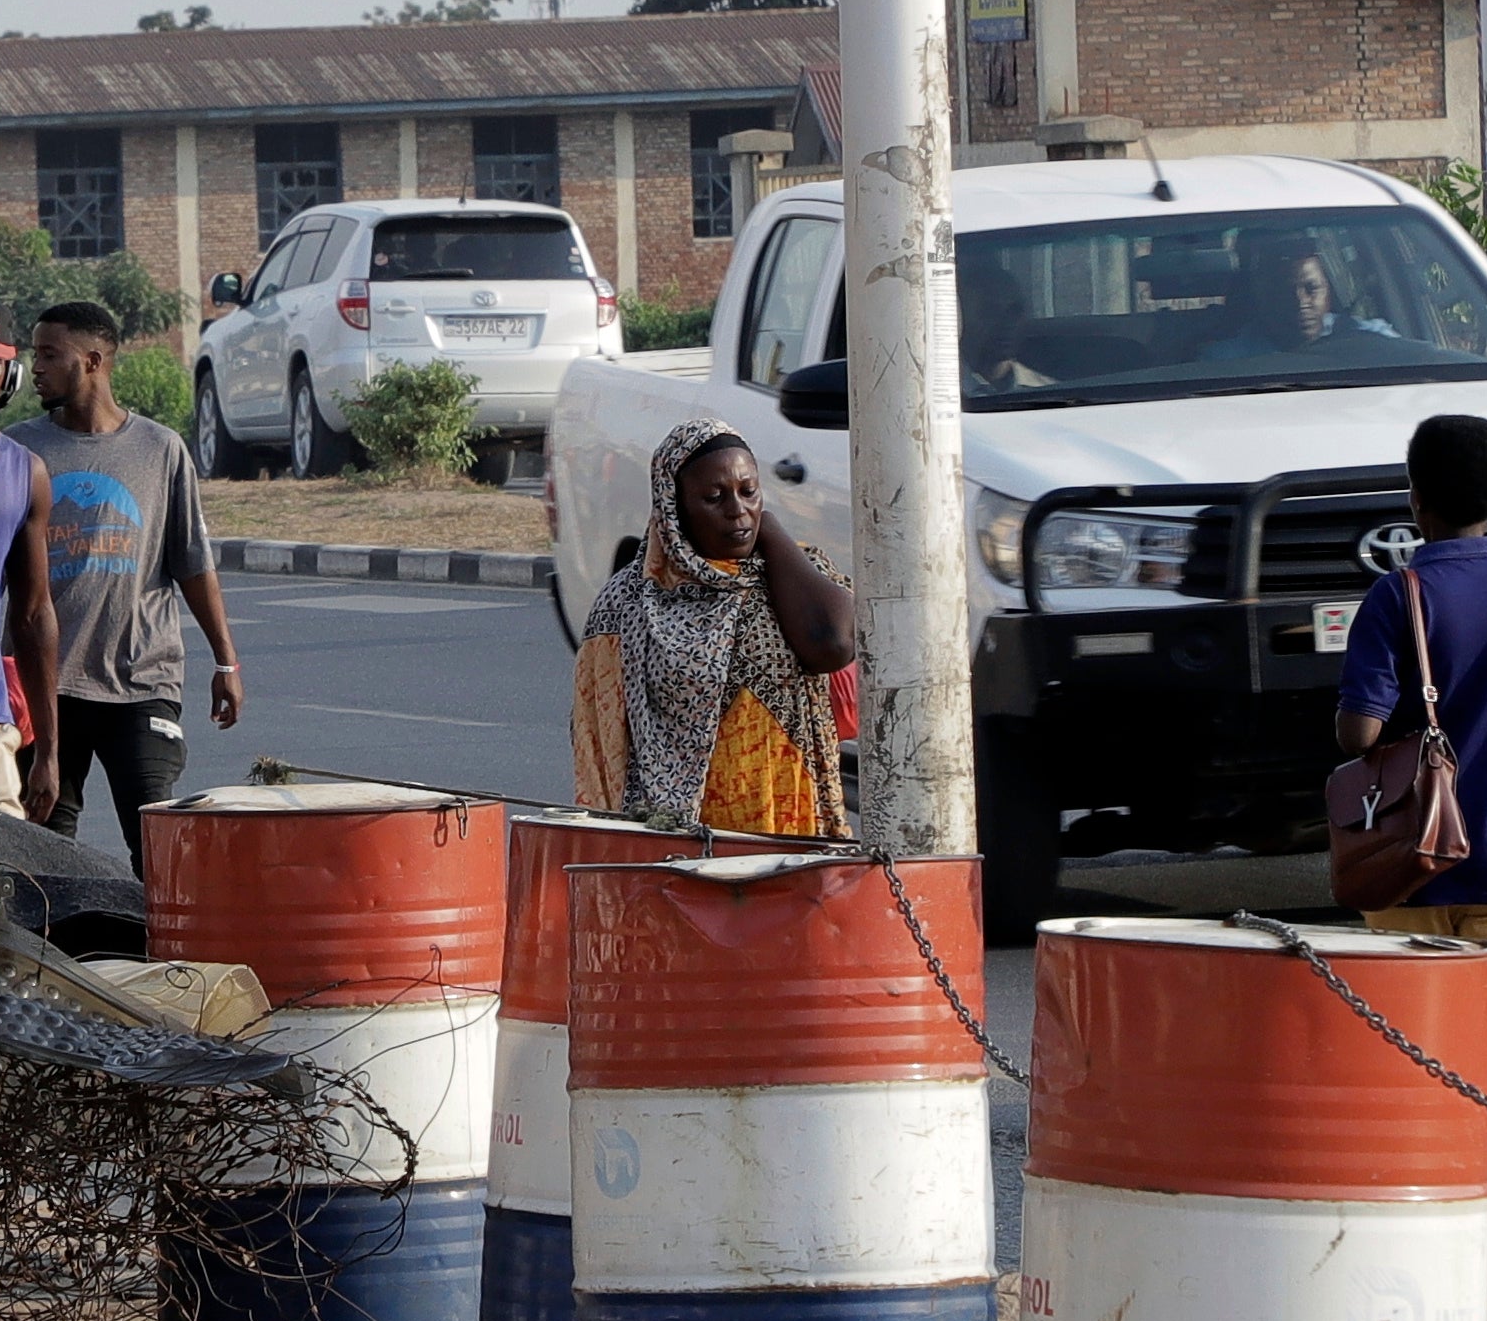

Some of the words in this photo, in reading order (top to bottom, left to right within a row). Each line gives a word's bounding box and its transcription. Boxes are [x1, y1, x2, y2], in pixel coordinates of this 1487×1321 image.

[46, 522, 79, 543] TAH
[68, 534, 132, 556] VALLEY
[50, 556, 137, 582] ARATHON
